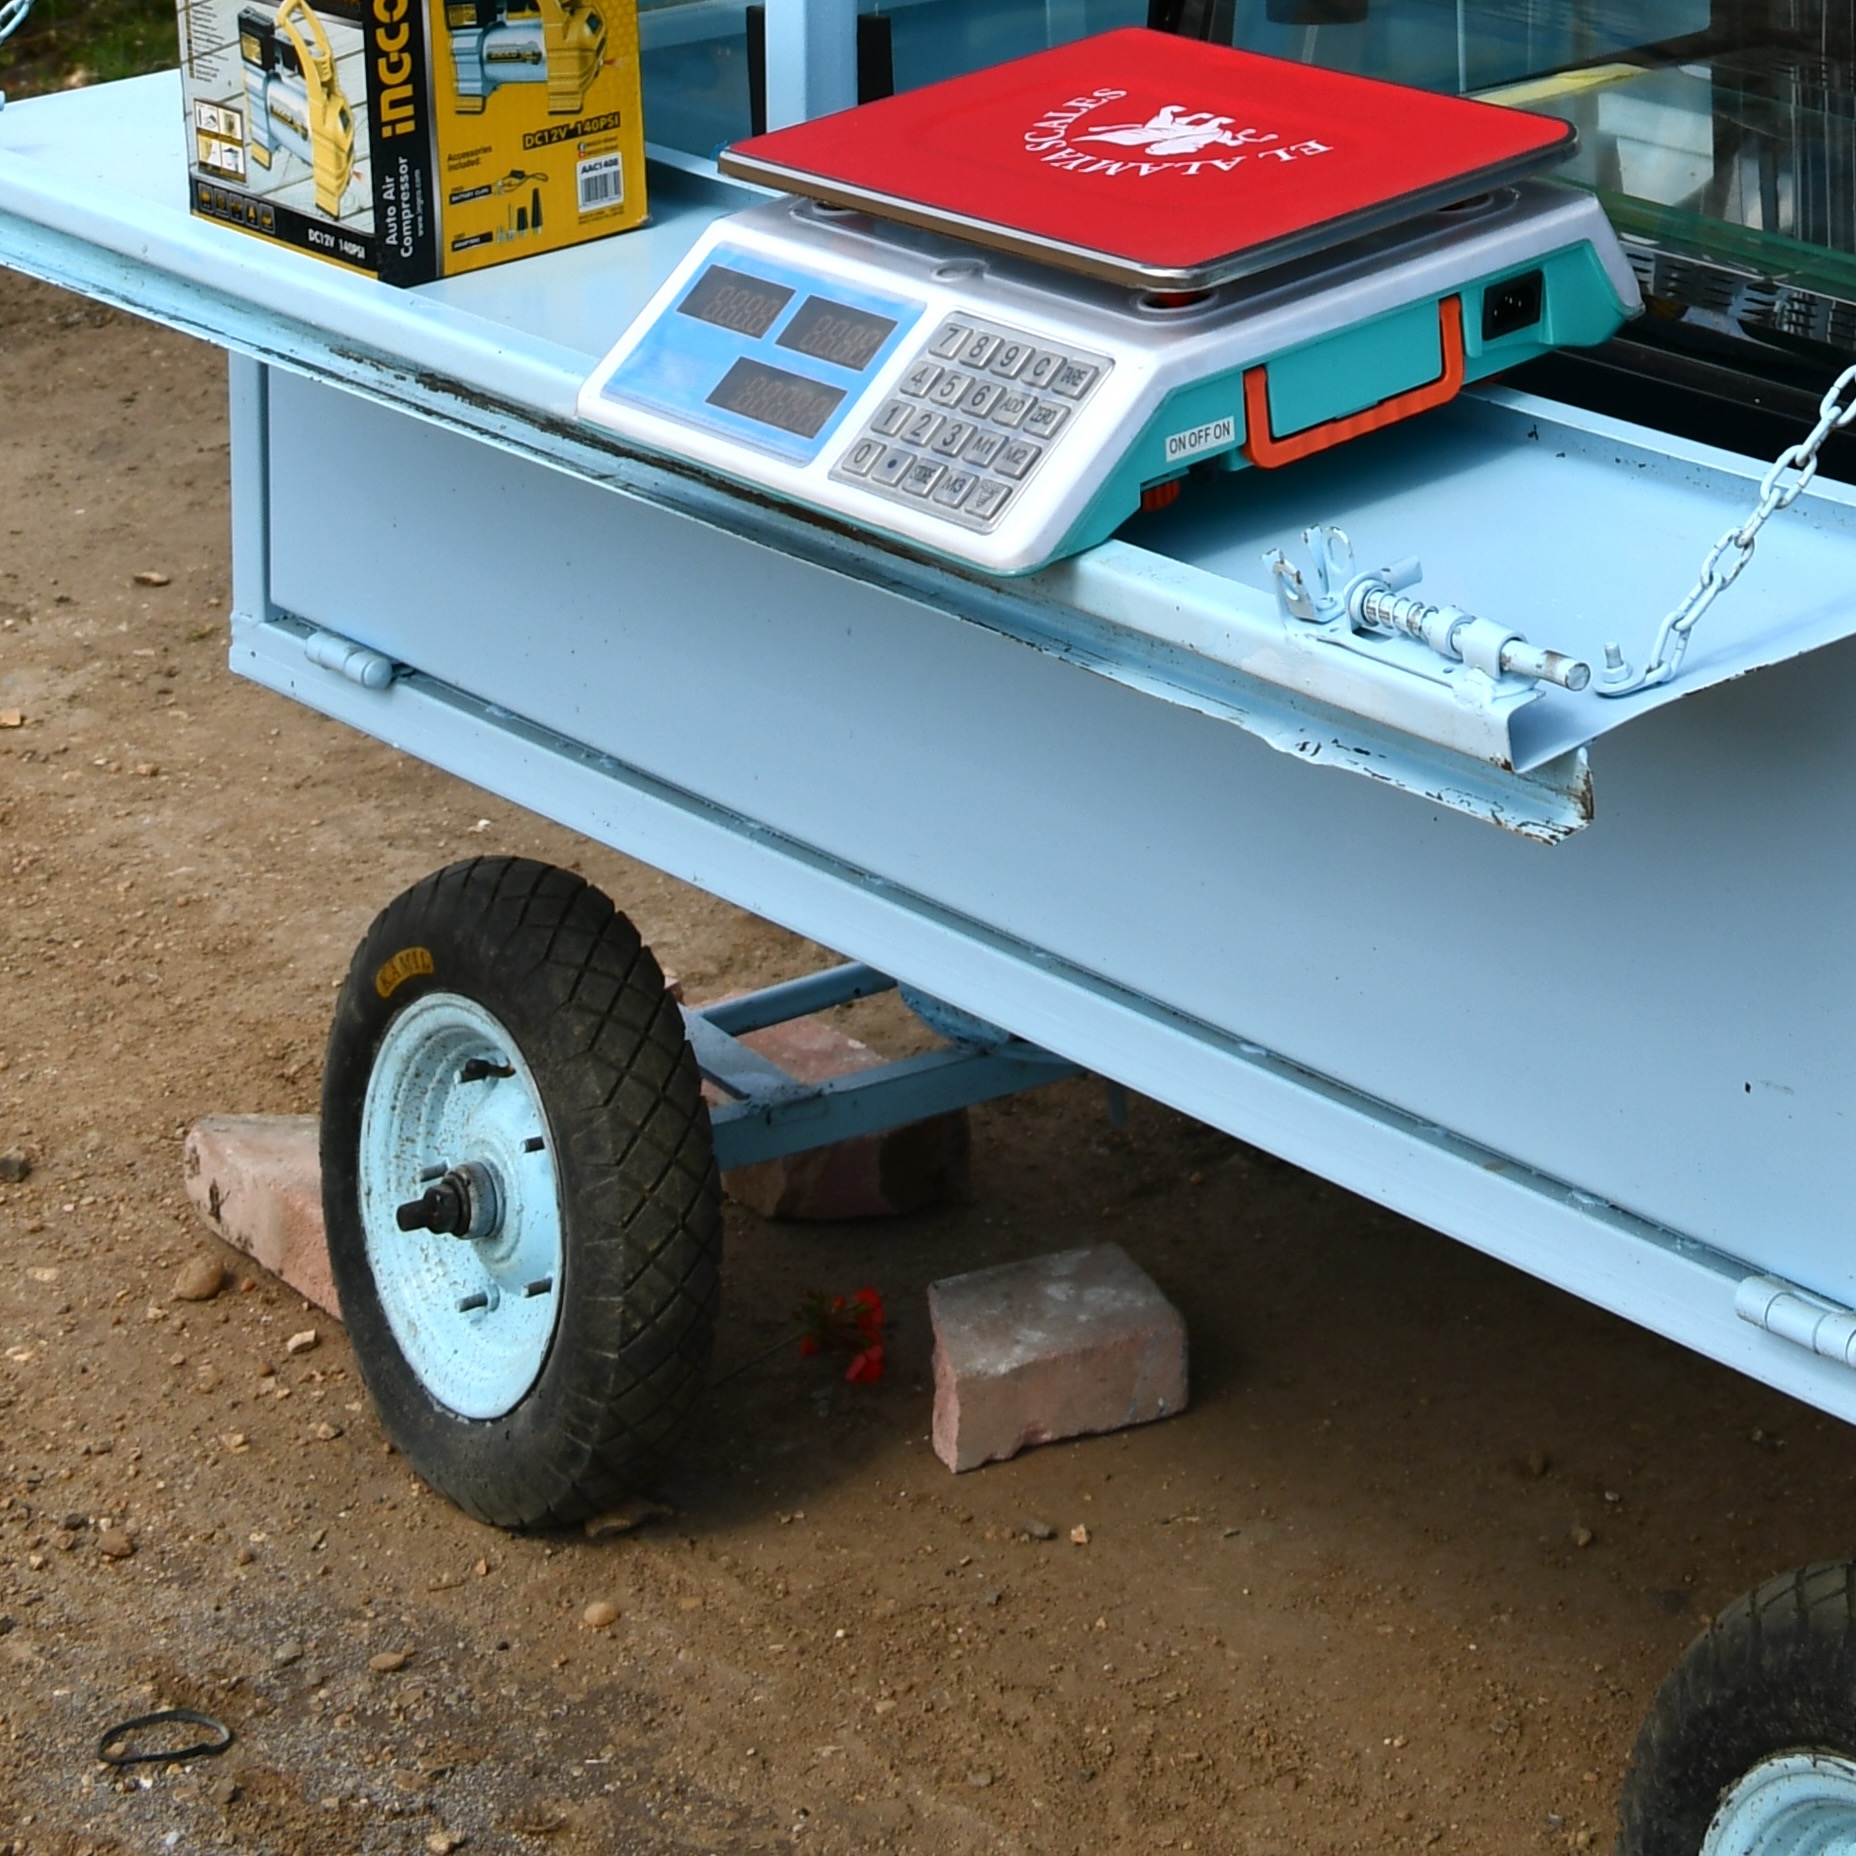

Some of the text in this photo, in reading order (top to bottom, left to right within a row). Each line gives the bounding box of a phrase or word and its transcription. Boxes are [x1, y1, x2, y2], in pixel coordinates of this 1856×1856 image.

[524, 125, 568, 148] DC12V
[576, 115, 620, 136] 140PSI
[1257, 139, 1334, 163] EL
[382, 174, 398, 246] Auto Air
[398, 156, 413, 258] Compressor
[939, 326, 959, 348] 7
[969, 335, 990, 358] 8
[1000, 345, 1019, 367] 9
[1032, 357, 1051, 377] C
[911, 366, 930, 387] 4
[939, 375, 961, 397] 5
[971, 385, 992, 407] 6
[1001, 396, 1026, 414] ADD
[852, 444, 873, 464] 0
[883, 405, 1028, 465] 1 2 3 M1 M2
[1168, 420, 1232, 456] ON OFF ON
